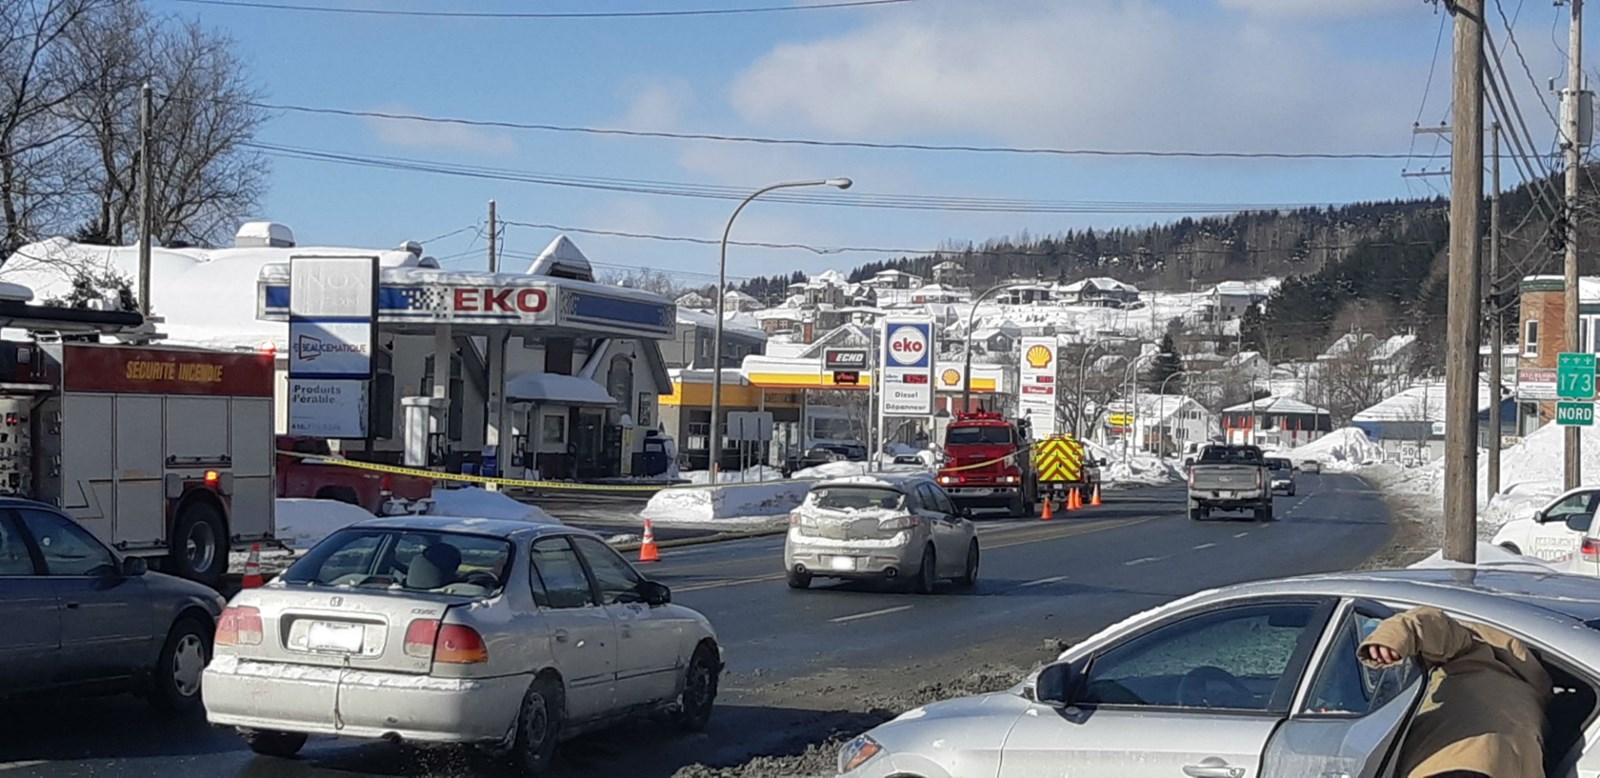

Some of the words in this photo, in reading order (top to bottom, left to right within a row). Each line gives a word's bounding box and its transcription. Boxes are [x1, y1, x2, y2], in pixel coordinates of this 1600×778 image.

[454, 288, 548, 312] EKO
[892, 338, 923, 352] eko
[178, 363, 224, 383] INCENDIE
[294, 384, 342, 395] Produits
[1561, 373, 1592, 392] 173
[885, 402, 926, 411] Dépanneur
[1558, 407, 1592, 421] NORD
[1402, 447, 1414, 456] 50
